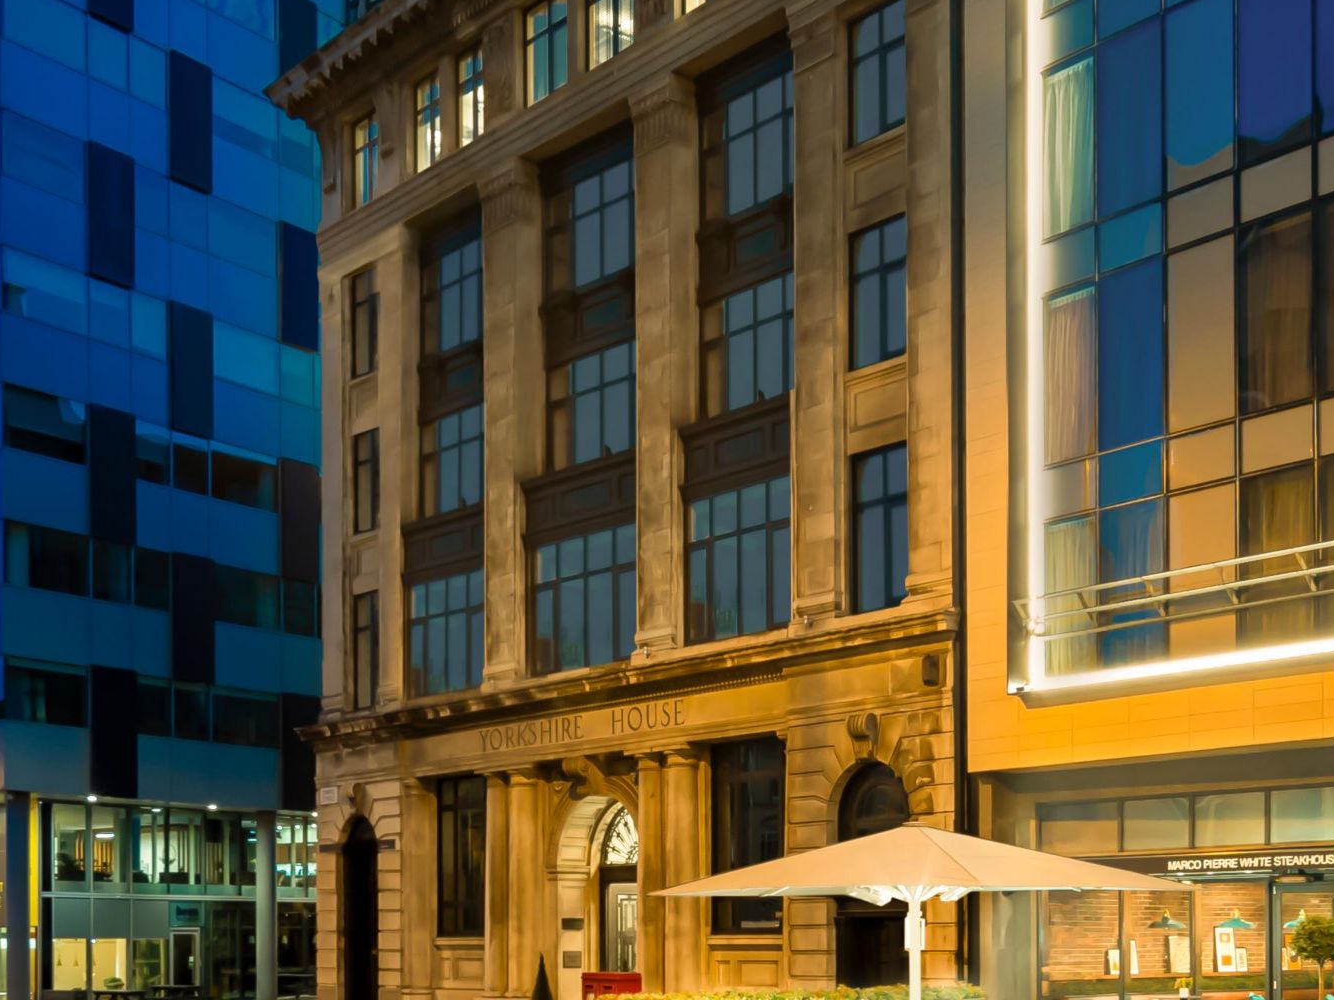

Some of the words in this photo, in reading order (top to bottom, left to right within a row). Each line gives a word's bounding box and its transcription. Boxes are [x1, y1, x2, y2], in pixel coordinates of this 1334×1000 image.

[478, 715, 584, 752] YORKSHIRE
[611, 699, 686, 735] HOUSE
[1167, 860, 1202, 871] MARCO
[1203, 858, 1239, 869] PIERRE
[1239, 856, 1272, 867] WHITE
